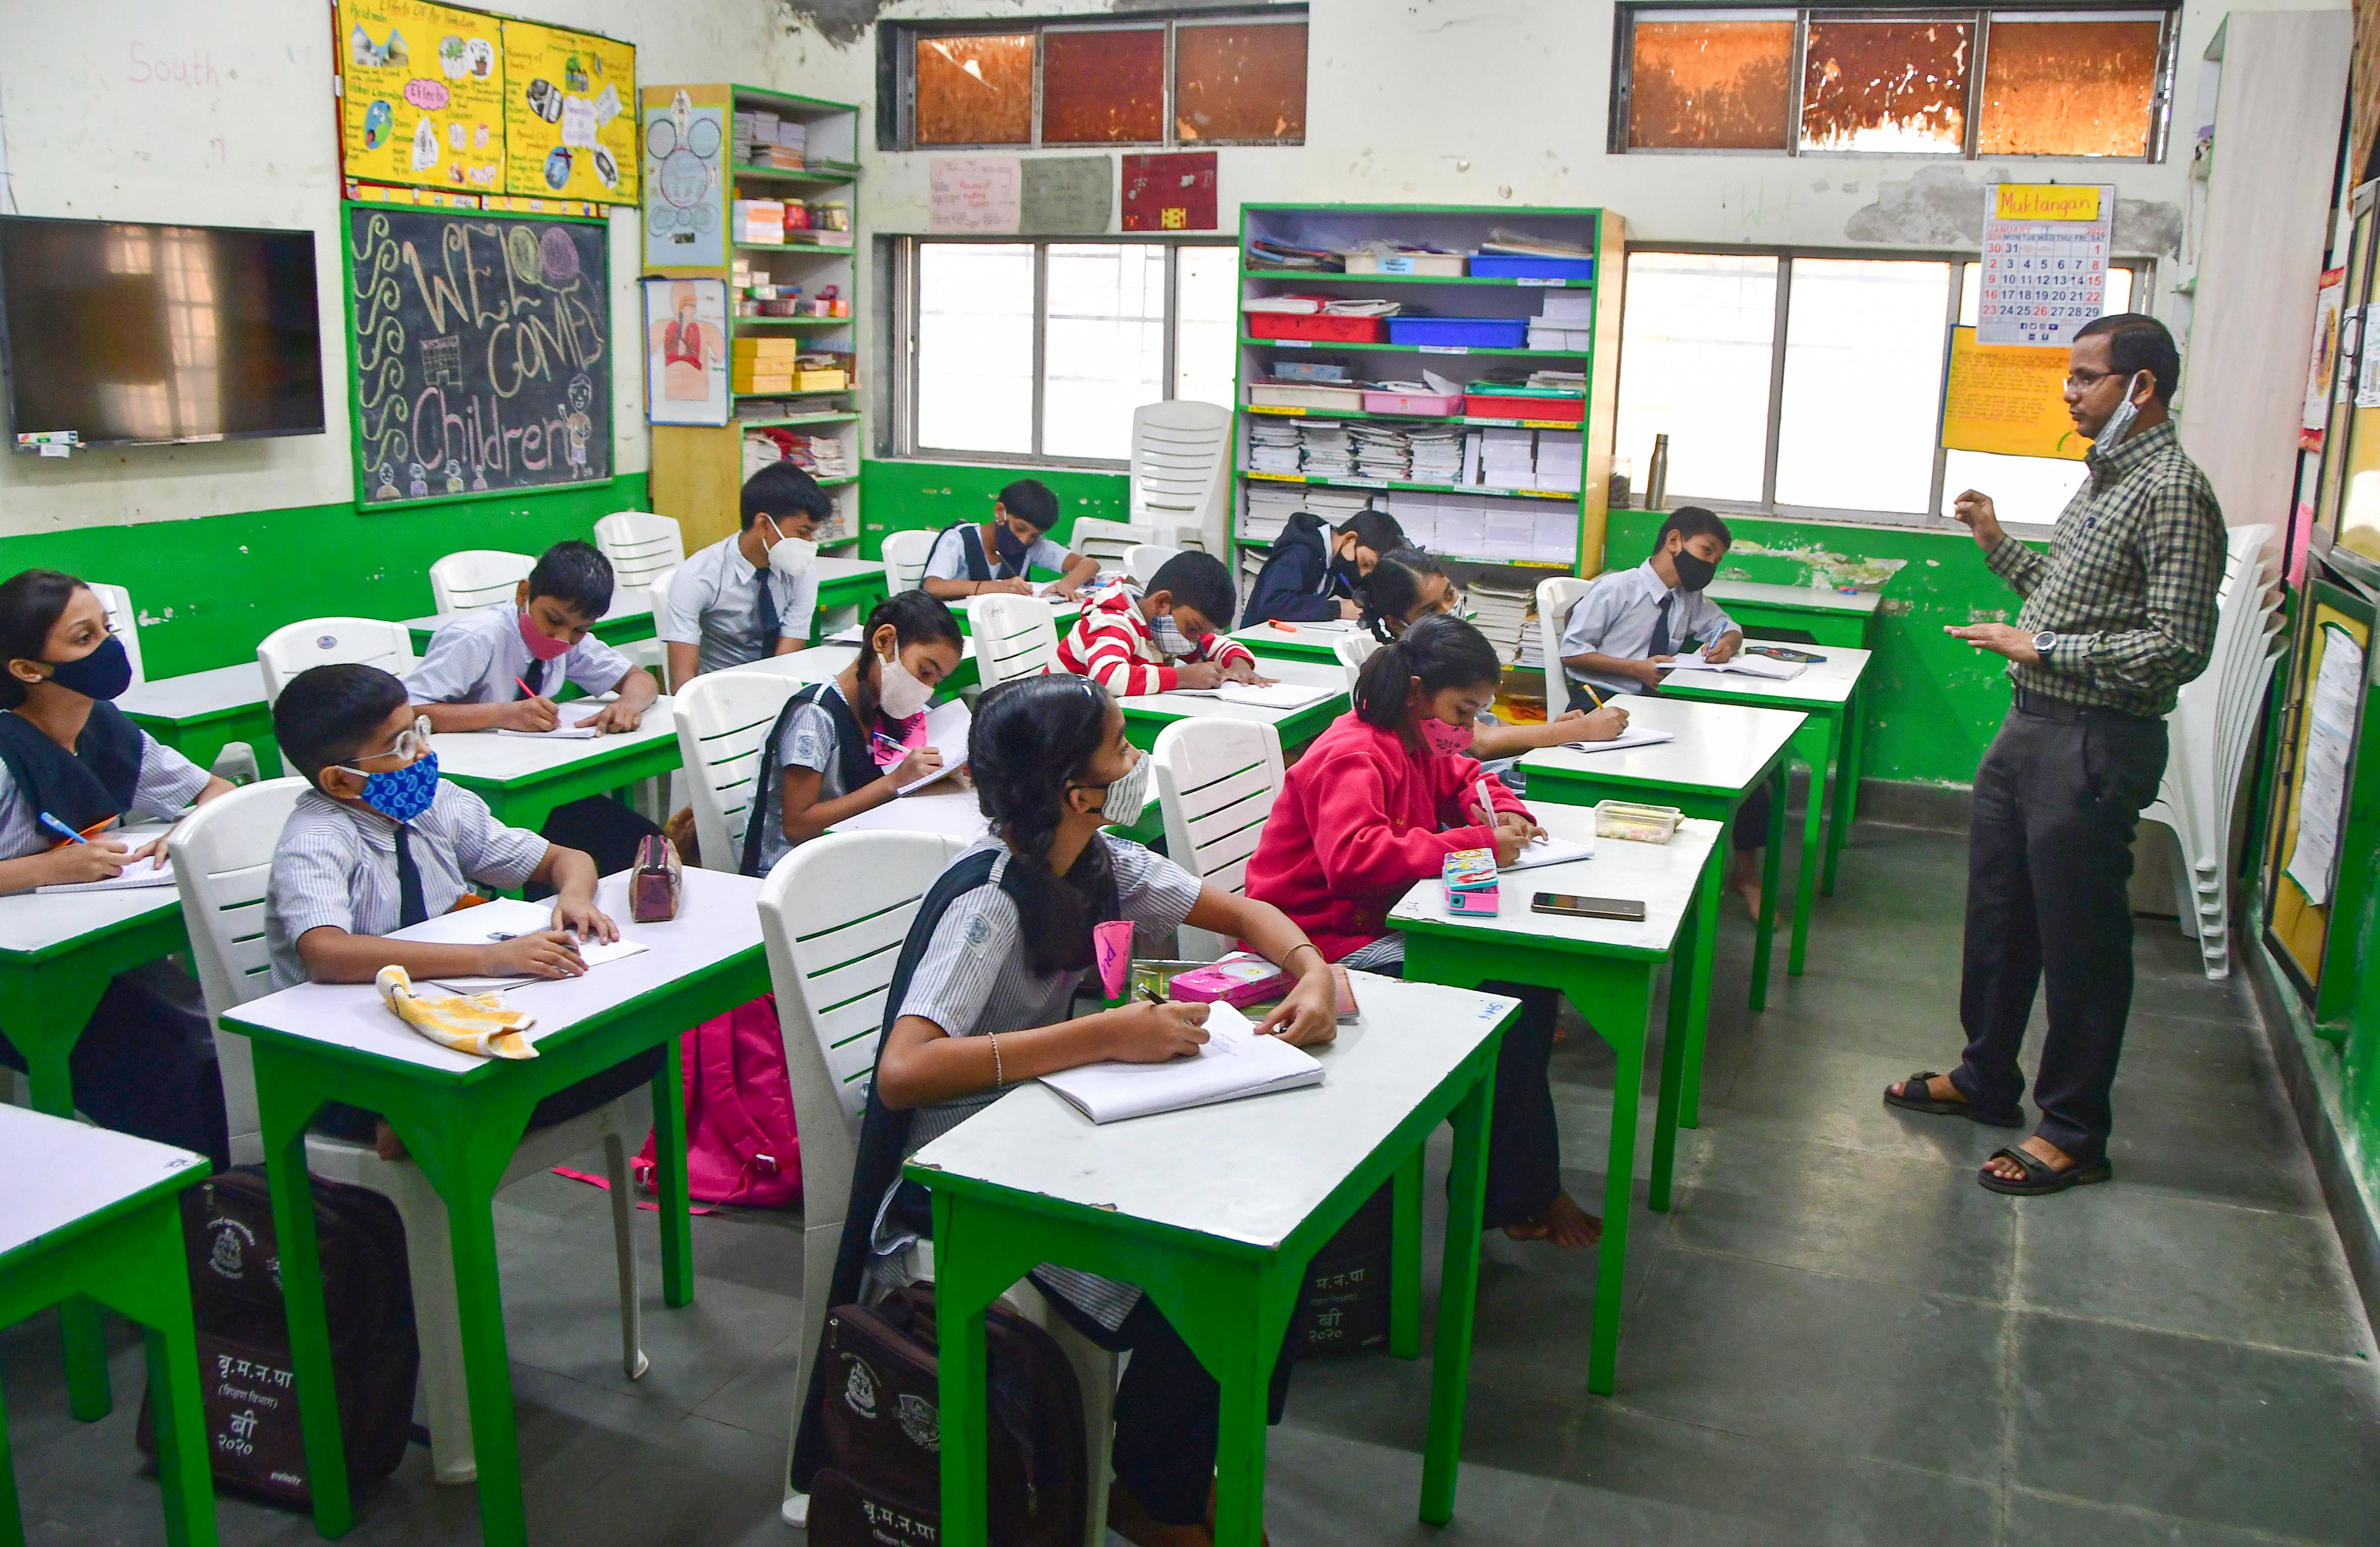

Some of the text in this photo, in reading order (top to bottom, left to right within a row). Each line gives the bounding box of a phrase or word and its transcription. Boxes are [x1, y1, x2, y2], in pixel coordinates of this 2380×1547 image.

[129, 41, 219, 86] South
[1988, 242, 2100, 254] 30 31 1
[1990, 259, 2099, 270] 2 3 4 5 6 7 8
[1989, 275, 2101, 286] 9 10 11 12 13 14 15
[1985, 290, 2100, 302] 16 17 18 19 20 21 22
[1984, 305, 2099, 317] 23 24 25 26 27 28 29
[414, 386, 577, 478] Children
[230, 1409, 258, 1439] बी
[218, 1433, 254, 1456] २०२०
